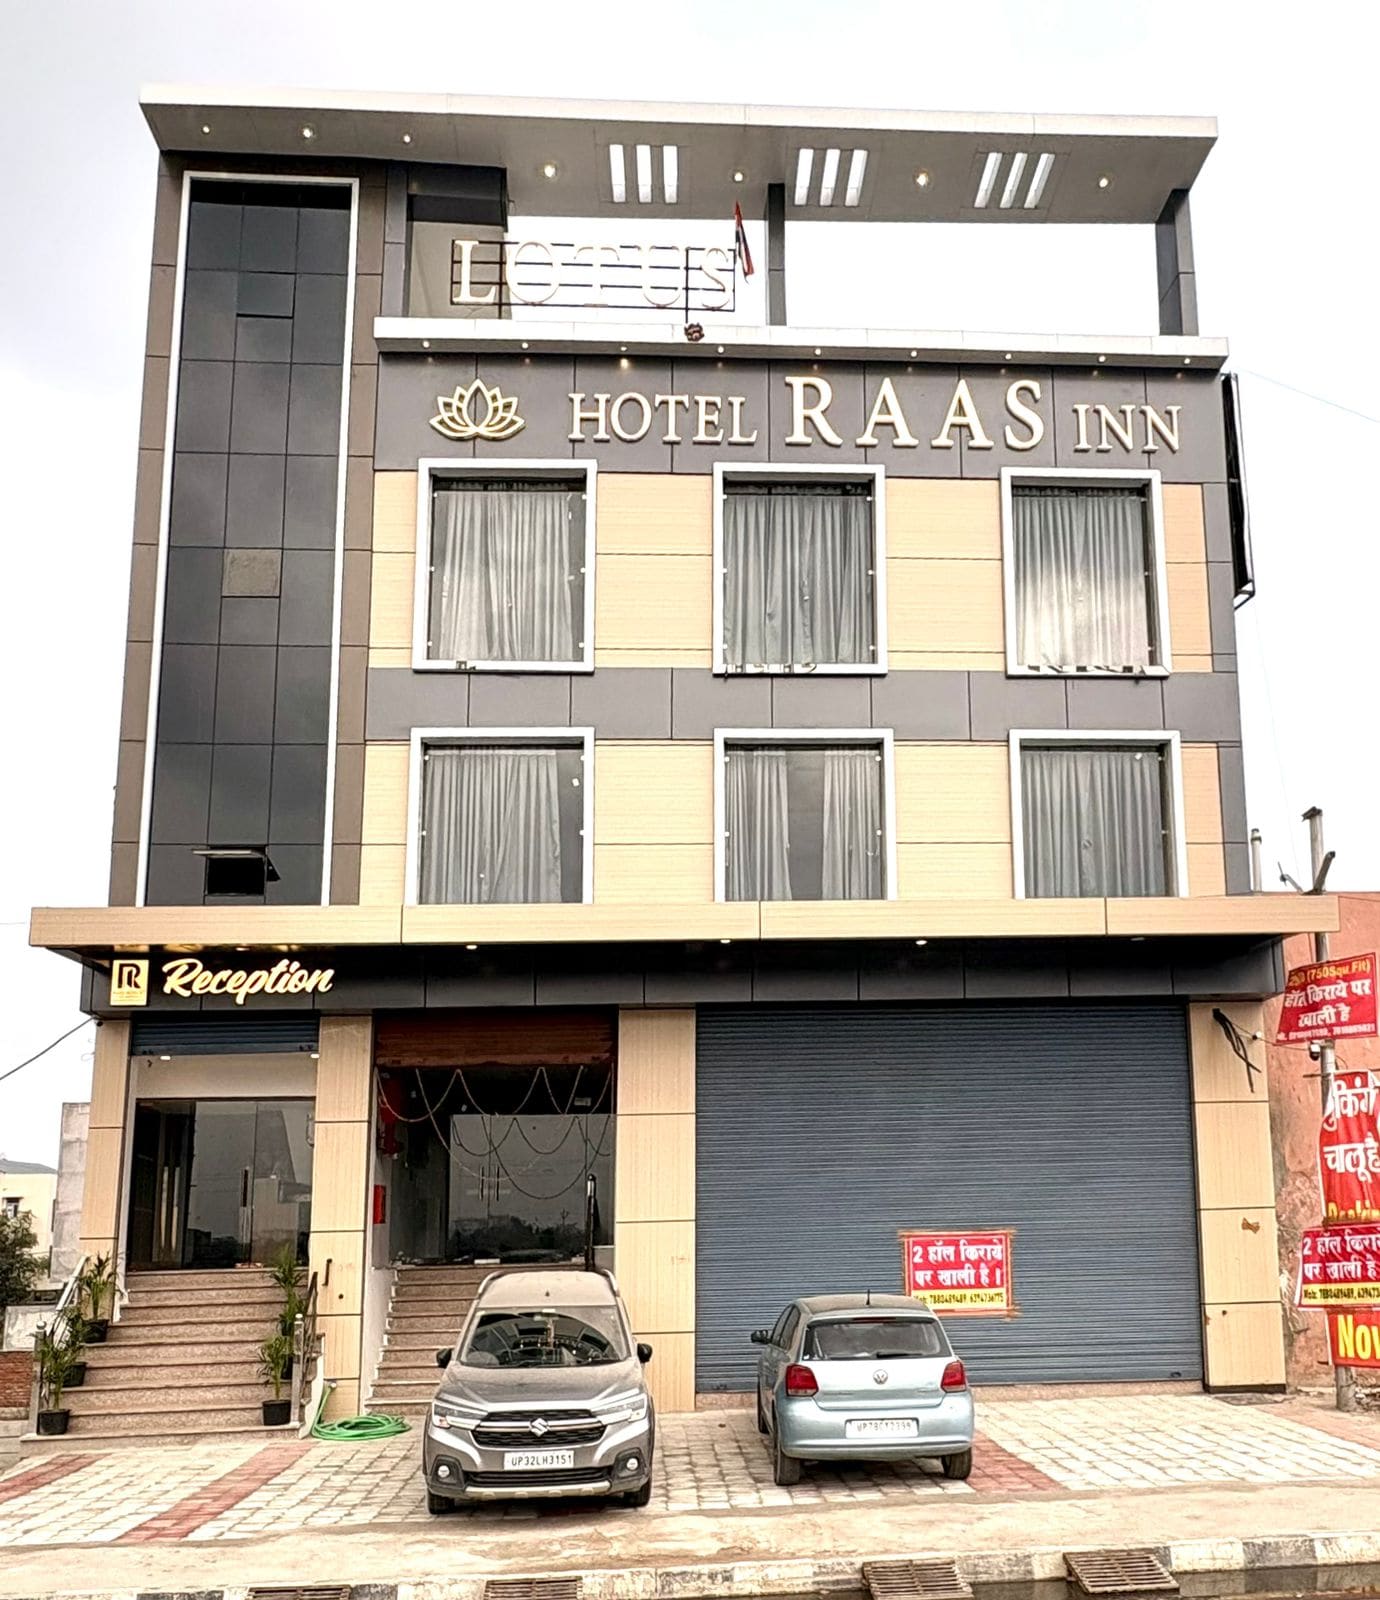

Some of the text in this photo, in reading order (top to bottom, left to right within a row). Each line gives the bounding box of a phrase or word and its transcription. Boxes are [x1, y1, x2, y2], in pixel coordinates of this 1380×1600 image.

[452, 240, 731, 310] LOTUS
[568, 376, 1182, 452] HOTEL RAAS INN
[162, 958, 335, 1005] Reception
[1350, 979, 1371, 995] पर
[913, 1239, 1003, 1265] 2 हॉल किराये
[1303, 1237, 1312, 1255] 2
[914, 1270, 935, 1287] पर
[937, 1263, 976, 1287] खाली
[1304, 1263, 1322, 1280] पर
[1326, 1255, 1362, 1280] खाली
[511, 1454, 572, 1466] UP32LH3151
